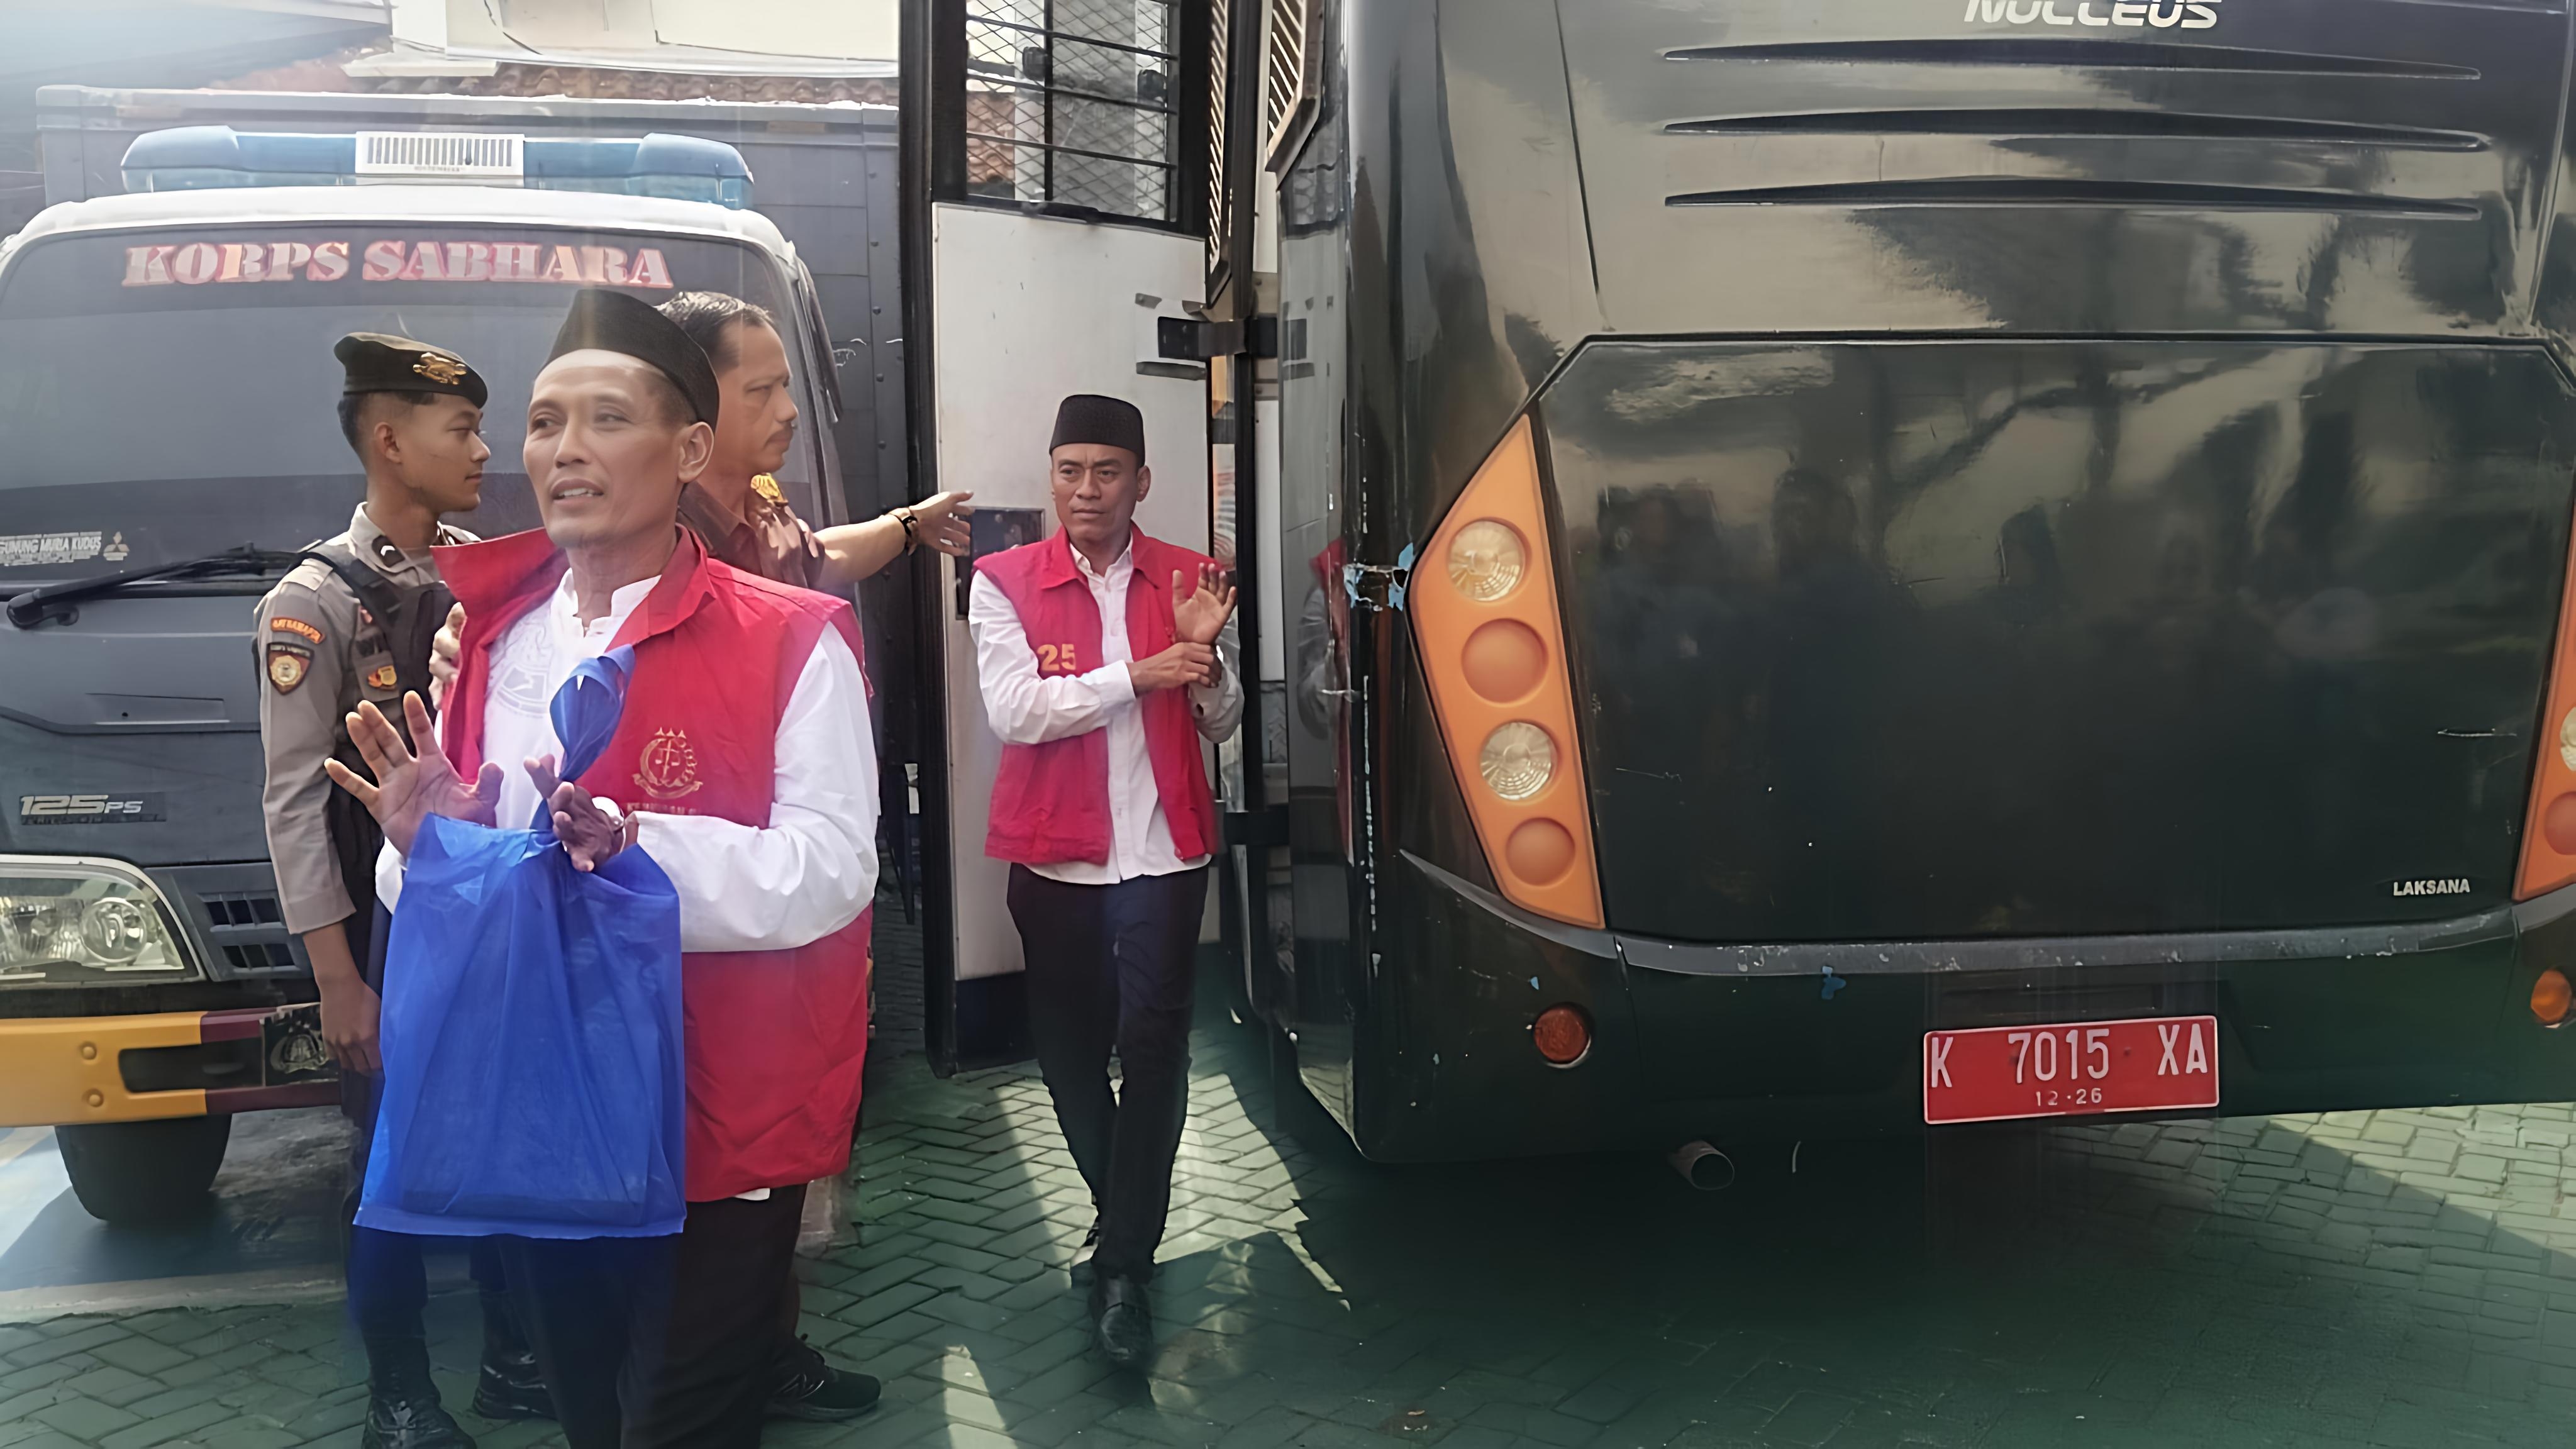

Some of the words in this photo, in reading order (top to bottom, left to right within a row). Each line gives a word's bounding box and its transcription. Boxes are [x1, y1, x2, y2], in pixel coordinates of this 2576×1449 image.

[1963, 0, 2223, 28] NUCLEUS
[122, 241, 350, 286] KORPS
[362, 240, 675, 289] SABHARA
[1037, 643, 1076, 671] 25
[2393, 879, 2470, 896] LAKSANA
[1931, 1036, 1953, 1088] K
[2008, 1028, 2110, 1084] 7015
[2157, 1023, 2208, 1076] XA
